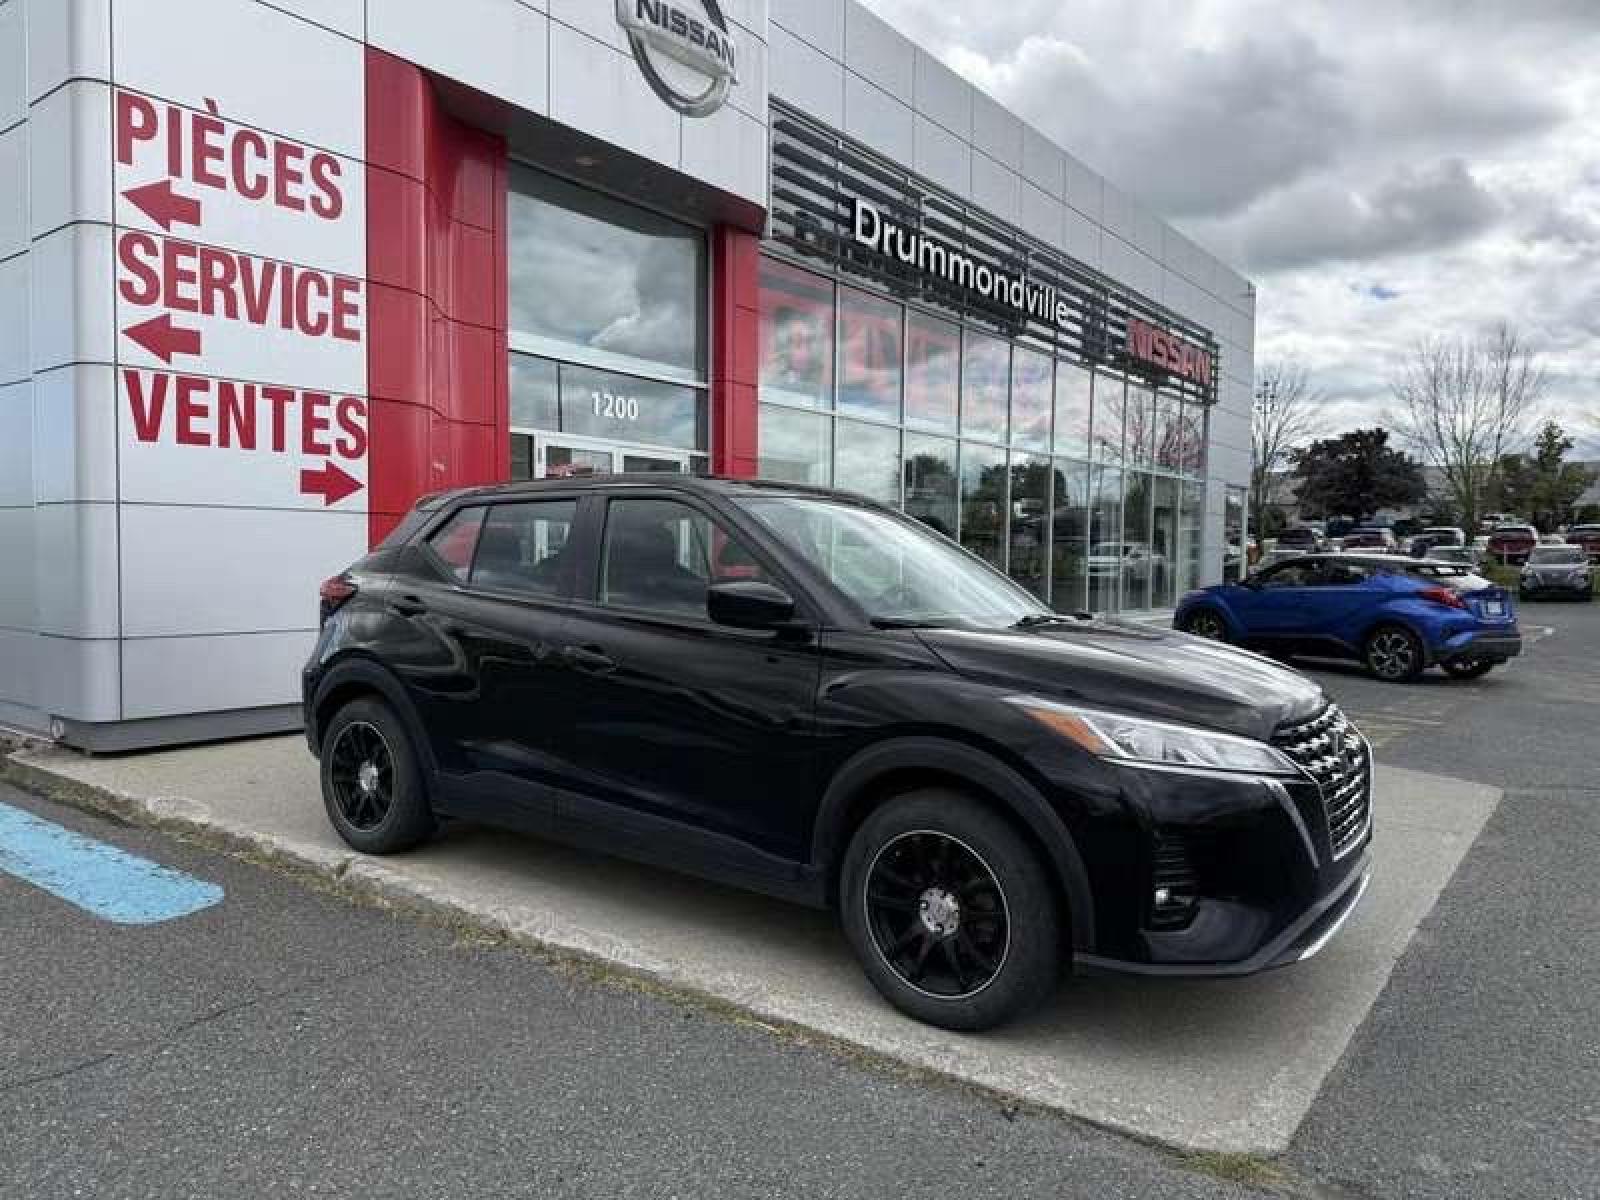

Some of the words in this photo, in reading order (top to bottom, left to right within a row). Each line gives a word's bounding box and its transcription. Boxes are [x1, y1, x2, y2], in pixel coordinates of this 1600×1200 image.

[637, 0, 735, 68] NISSAN
[117, 91, 342, 219] PIÈCES
[118, 231, 361, 341] SERVICE
[856, 199, 1068, 326] Drummondville
[1127, 320, 1211, 384] NISSAN
[123, 369, 367, 460] VENTES
[591, 392, 639, 420] 1200
